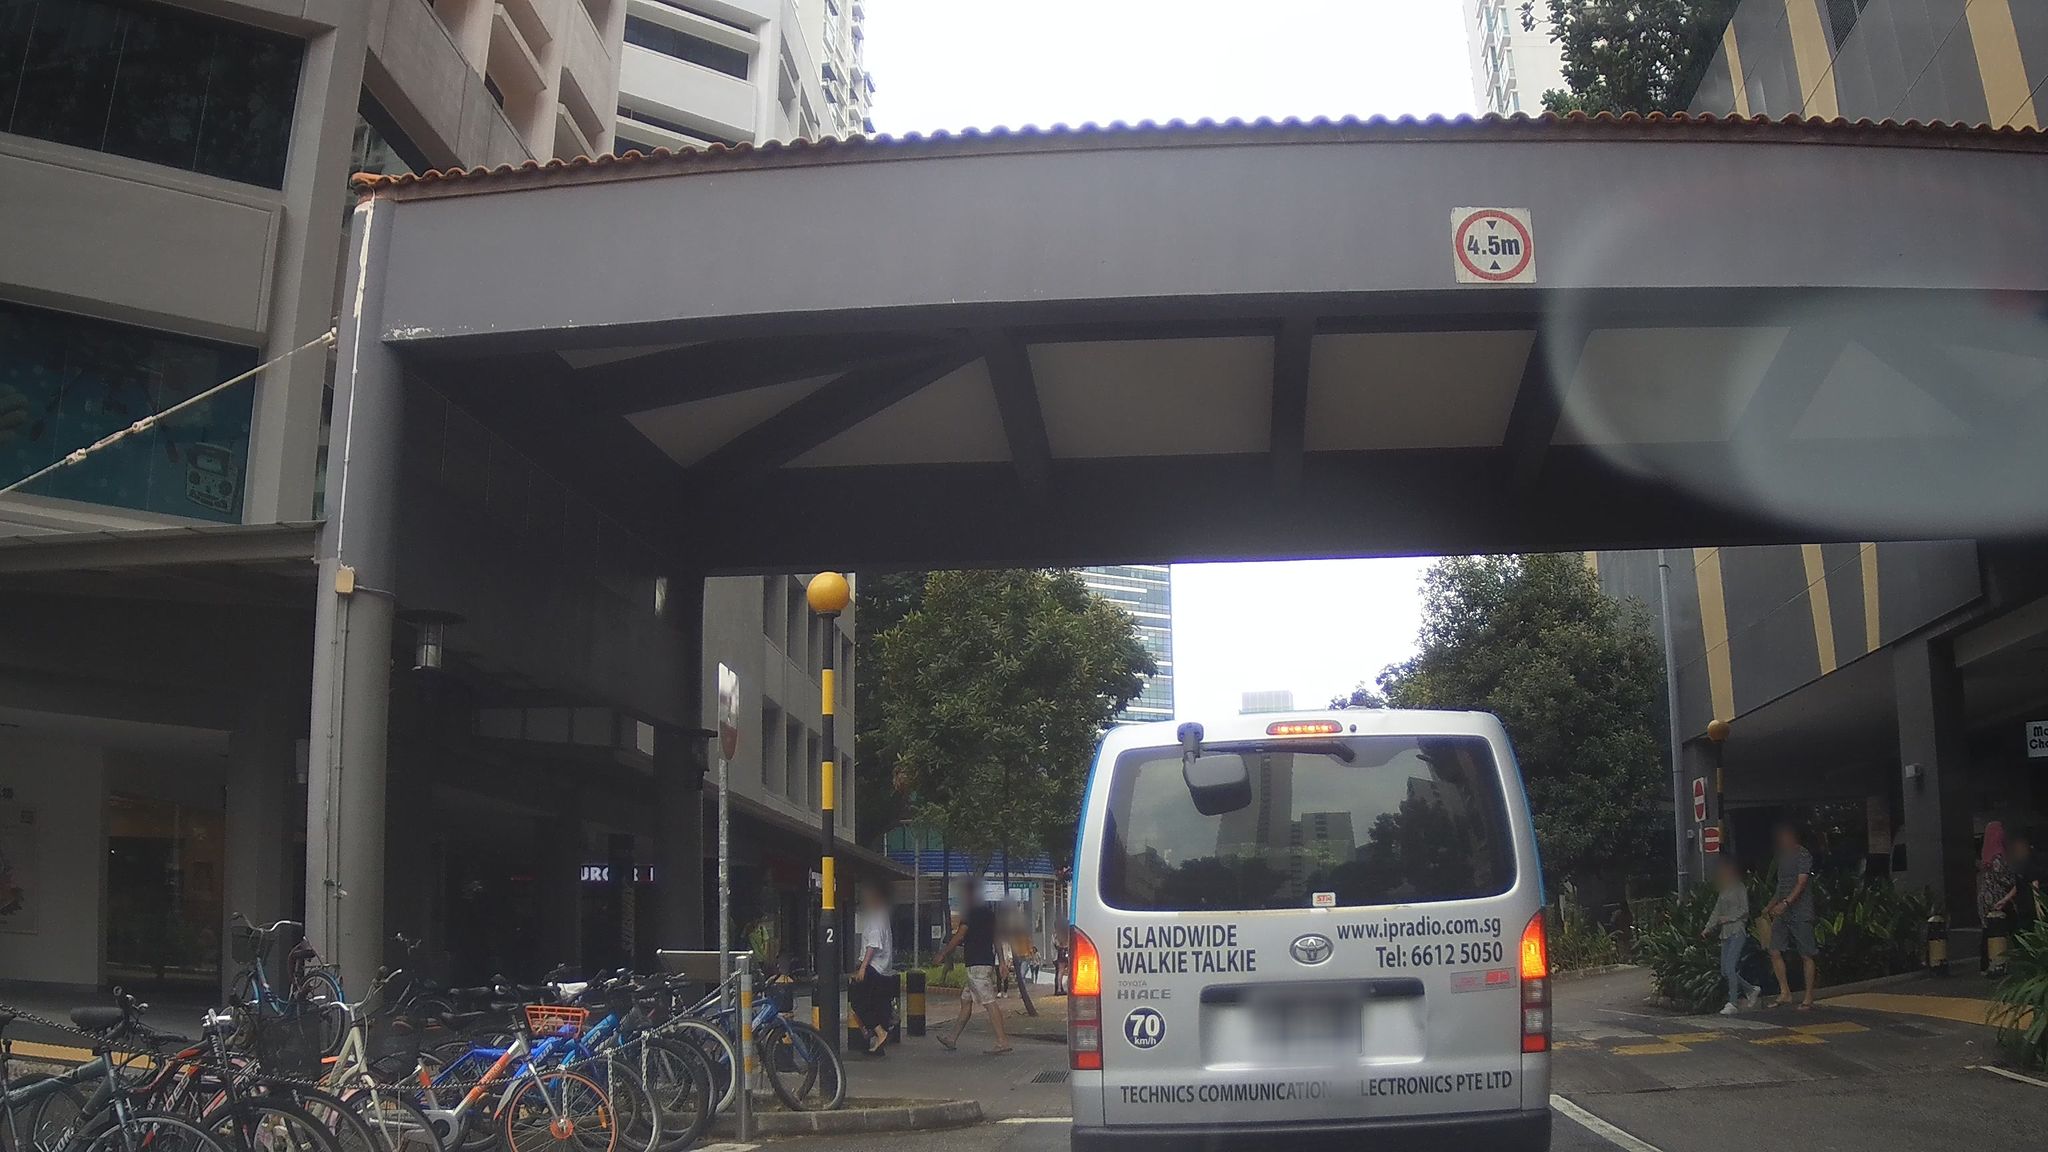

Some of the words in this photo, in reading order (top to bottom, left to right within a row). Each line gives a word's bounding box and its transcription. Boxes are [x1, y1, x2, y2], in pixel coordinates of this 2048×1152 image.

[1467, 235, 1520, 255] 4.5m
[826, 928, 834, 943] 2
[1116, 924, 1237, 949] ISLANDWIDE
[1337, 916, 1501, 942] www.ipradio.com.sg
[1116, 951, 1188, 974] WALKIE
[1191, 949, 1257, 973] TALKIE
[1376, 945, 1407, 968] Tel:
[1411, 945, 1455, 967] 6612
[1460, 941, 1503, 964] 5050
[1117, 988, 1171, 1000] HIACE
[1130, 1014, 1161, 1037] 70
[1134, 1036, 1157, 1045] km/h
[1120, 1085, 1195, 1103] TECHNICS
[1357, 1075, 1452, 1097] LECTRONICS
[1456, 1072, 1483, 1092] PTE
[1486, 1070, 1512, 1090] LTD
